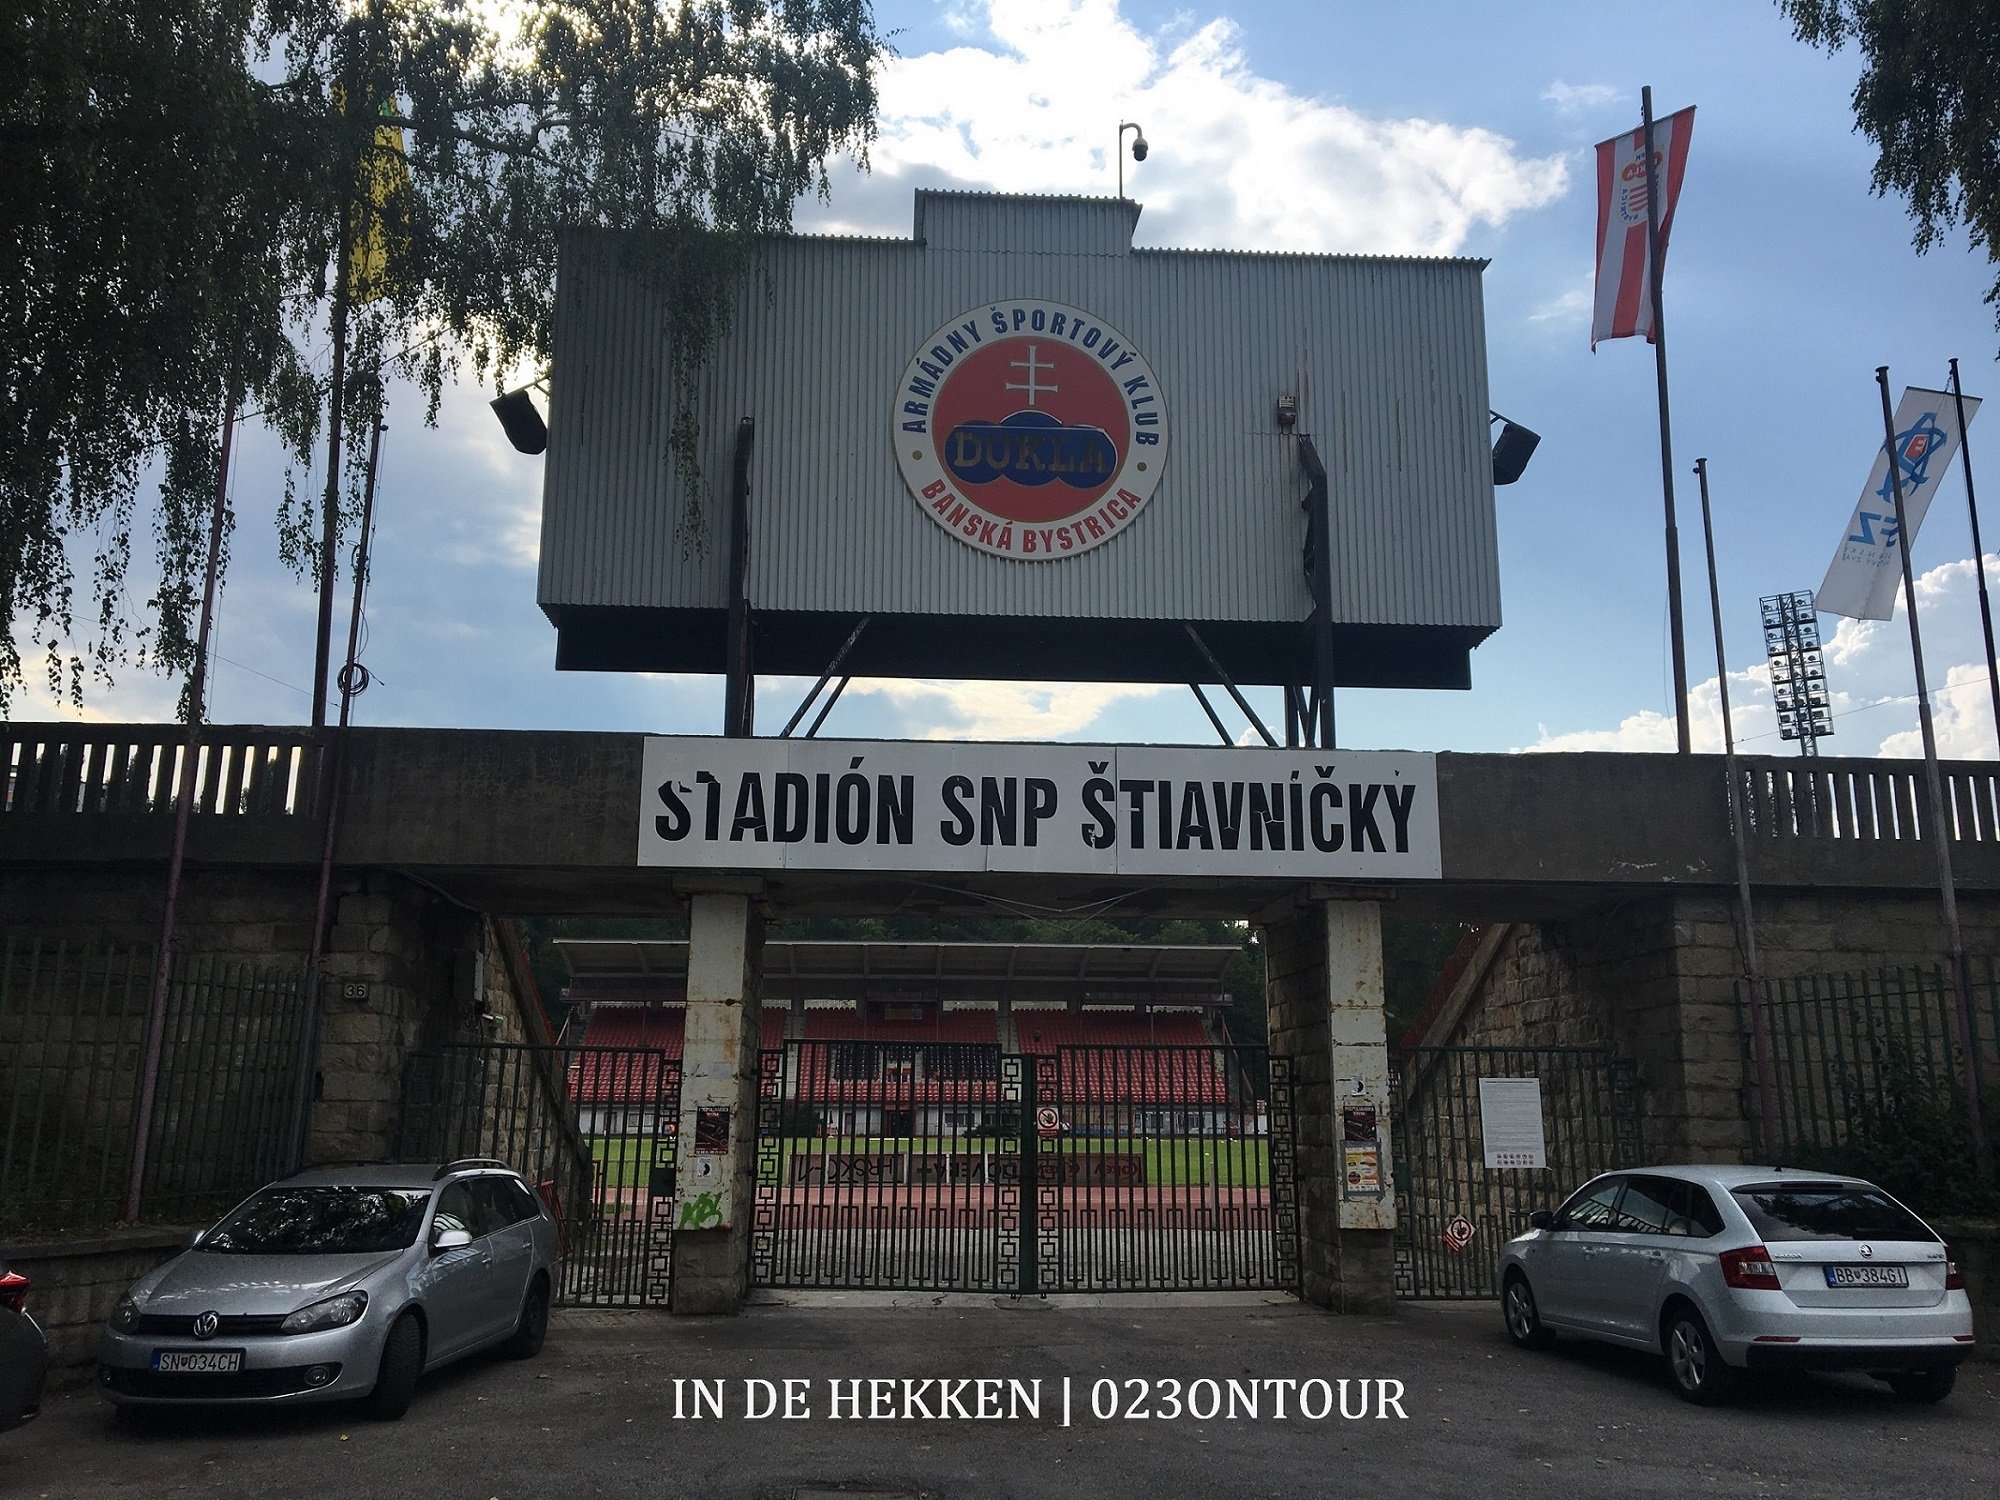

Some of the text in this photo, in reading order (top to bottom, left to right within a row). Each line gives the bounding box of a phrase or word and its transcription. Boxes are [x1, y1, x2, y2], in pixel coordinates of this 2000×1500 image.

[903, 306, 1159, 446] ARMÁDNY ŠPORTOVÝ KLUB
[953, 431, 1110, 474] DUKLA
[921, 478, 1141, 553] BANSKÁ BYSTRICA
[655, 757, 914, 845] STADIÓN
[940, 775, 1058, 847] SNP
[346, 985, 365, 997] 36
